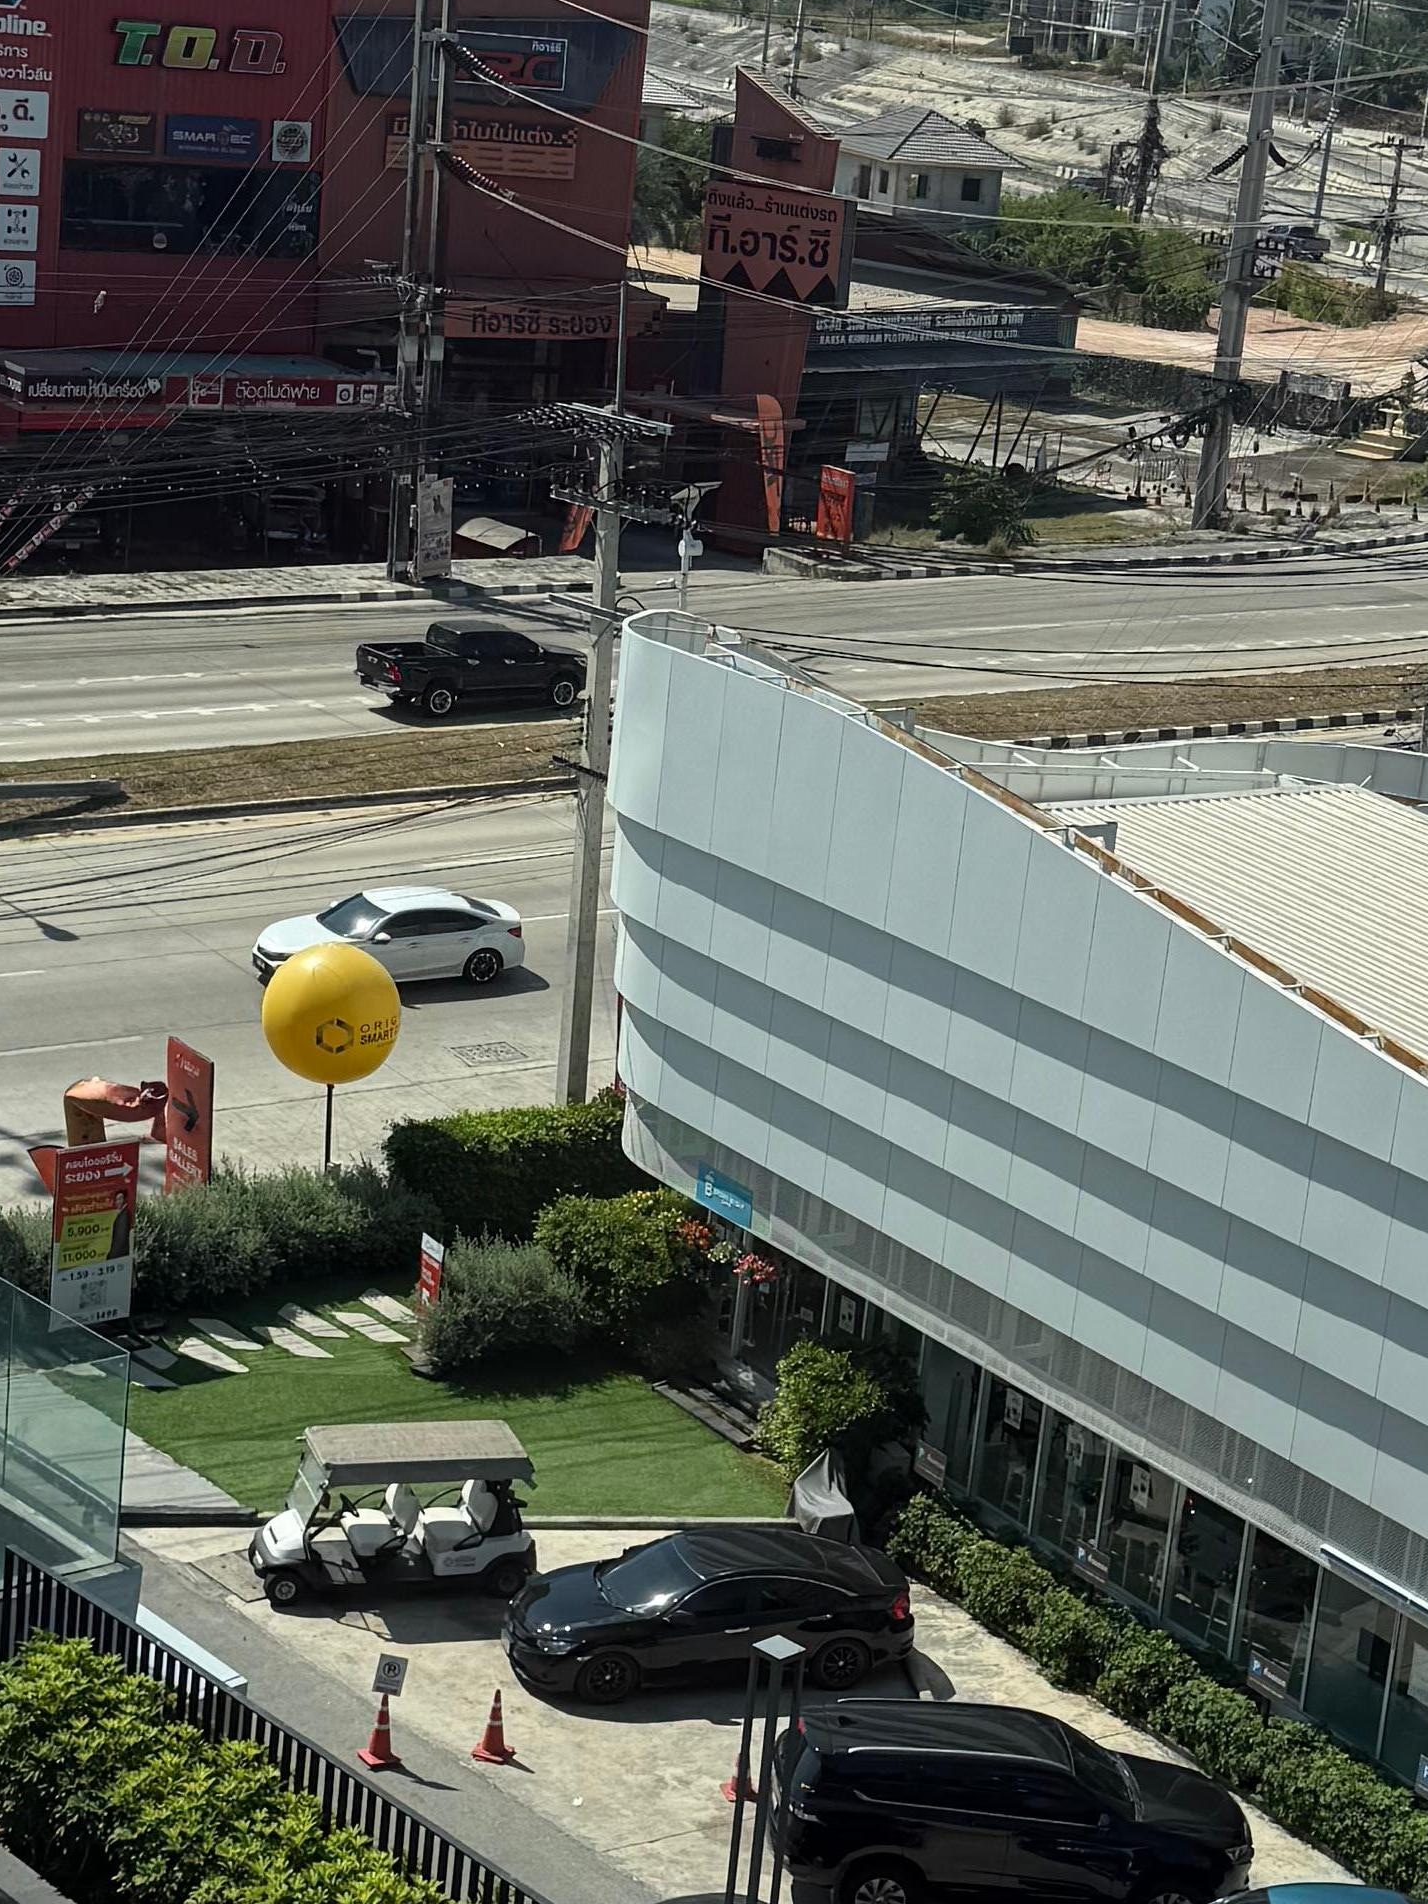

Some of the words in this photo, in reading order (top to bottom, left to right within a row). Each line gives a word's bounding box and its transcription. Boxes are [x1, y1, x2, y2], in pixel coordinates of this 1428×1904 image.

[547, 313, 613, 338] ระยอง
[173, 1136, 198, 1163] SALES
[65, 1169, 101, 1185] ระยอง
